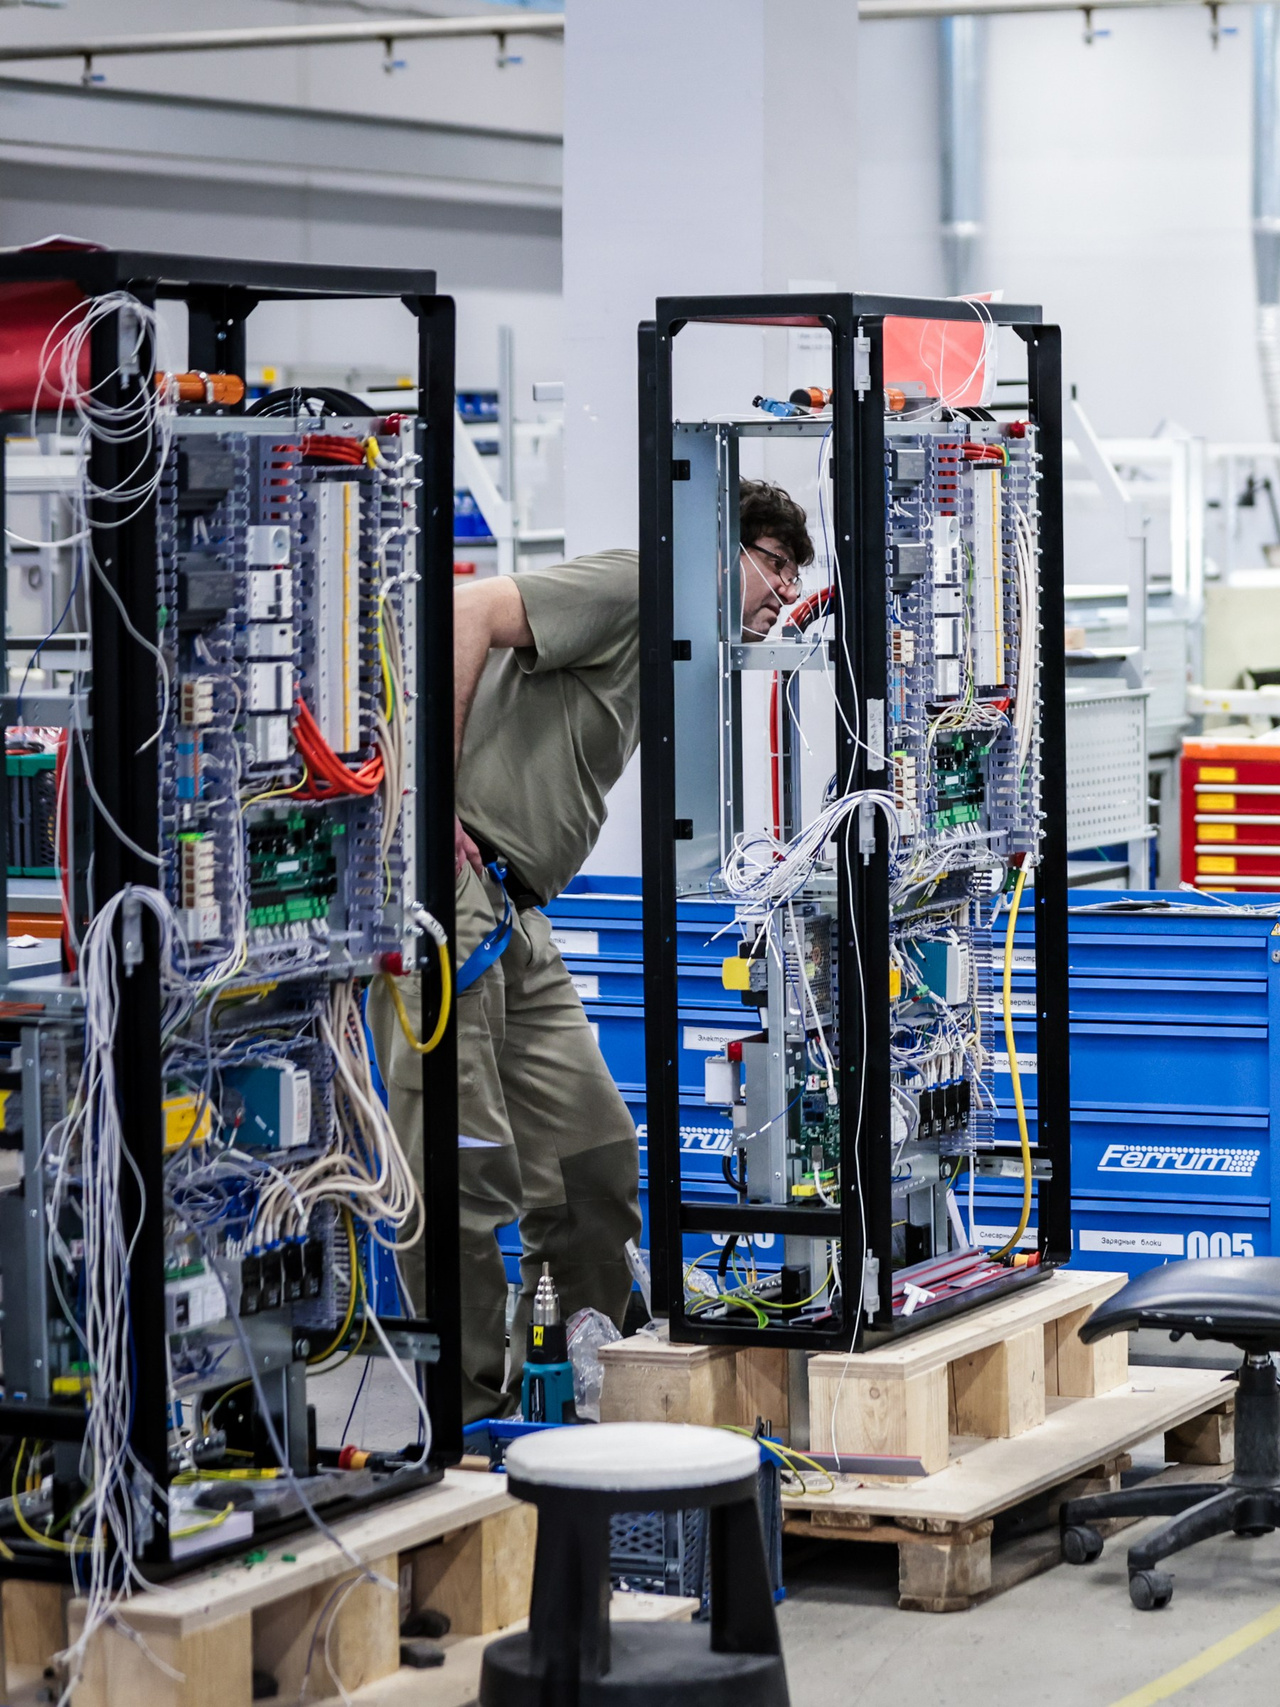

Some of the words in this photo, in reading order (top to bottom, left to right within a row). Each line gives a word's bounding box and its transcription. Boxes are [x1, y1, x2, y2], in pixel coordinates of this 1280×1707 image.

[1099, 1144, 1234, 1171] Ferrum
[1101, 1236, 1136, 1247] Зарядные
[1141, 1238, 1162, 1247] блоки
